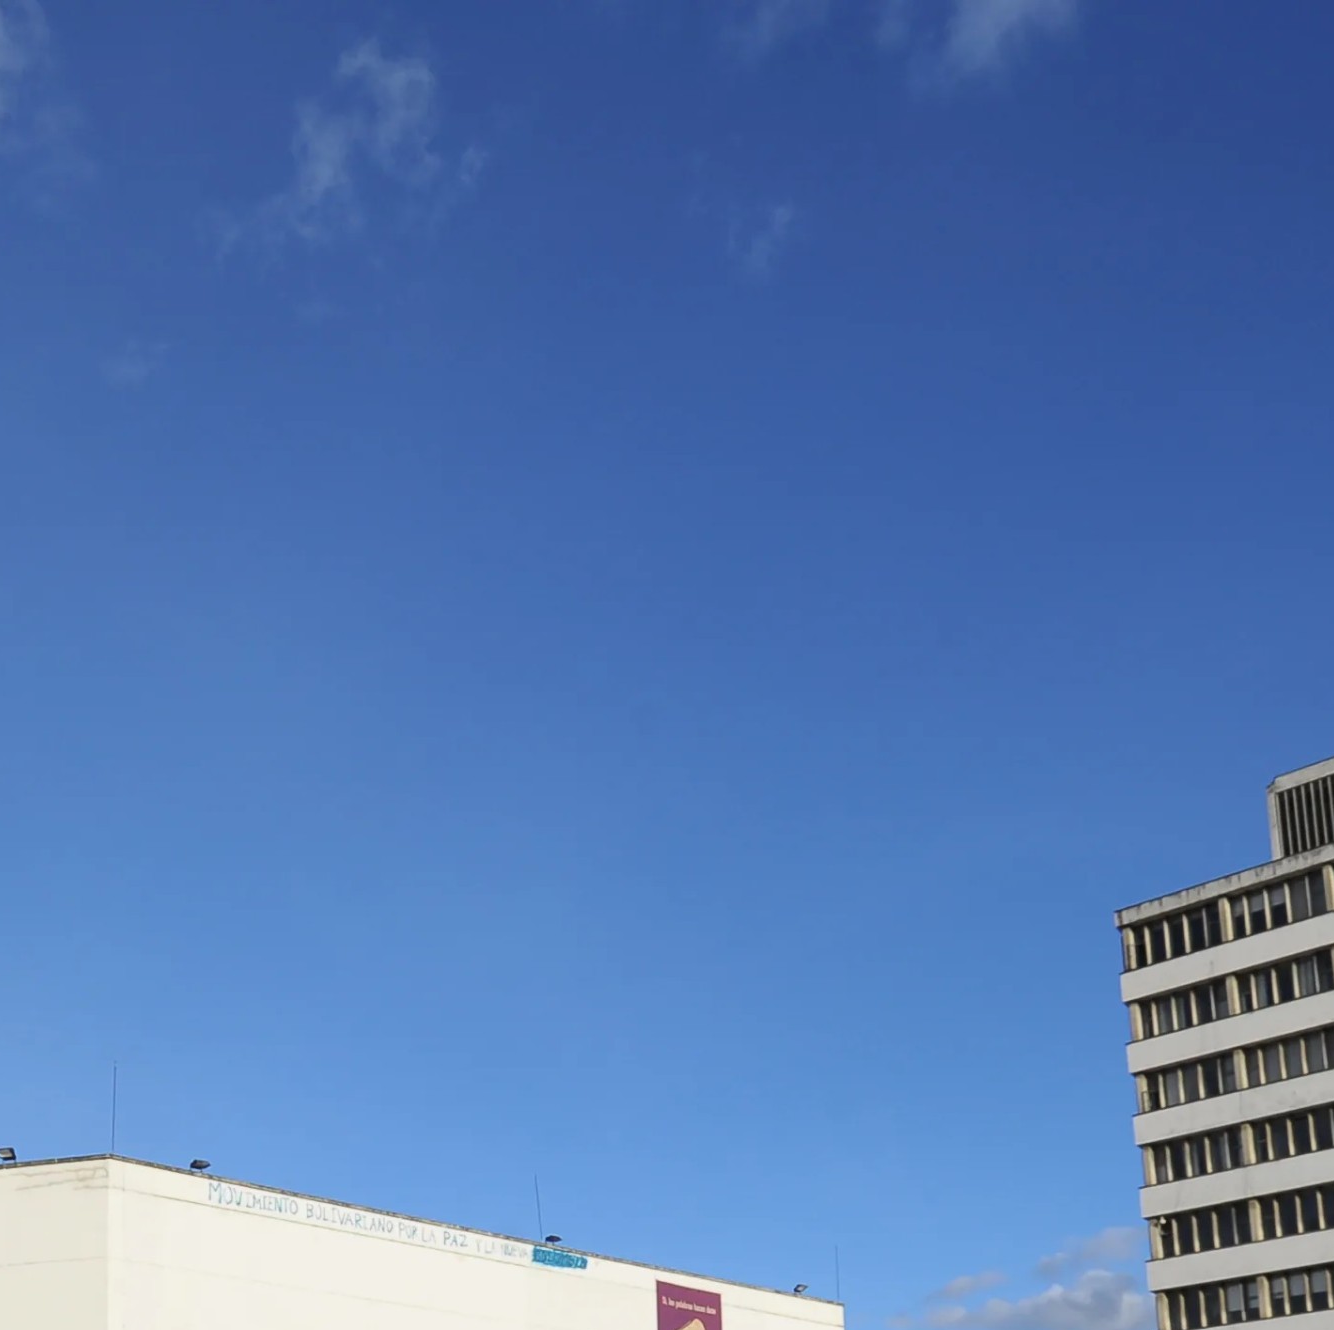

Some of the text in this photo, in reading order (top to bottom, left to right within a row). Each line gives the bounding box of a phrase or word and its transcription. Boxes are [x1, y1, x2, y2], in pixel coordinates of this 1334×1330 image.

[207, 1182, 299, 1215] MOVIMIENTO
[306, 1203, 394, 1234] BOLIVARIANO
[443, 1231, 469, 1248] PAZ
